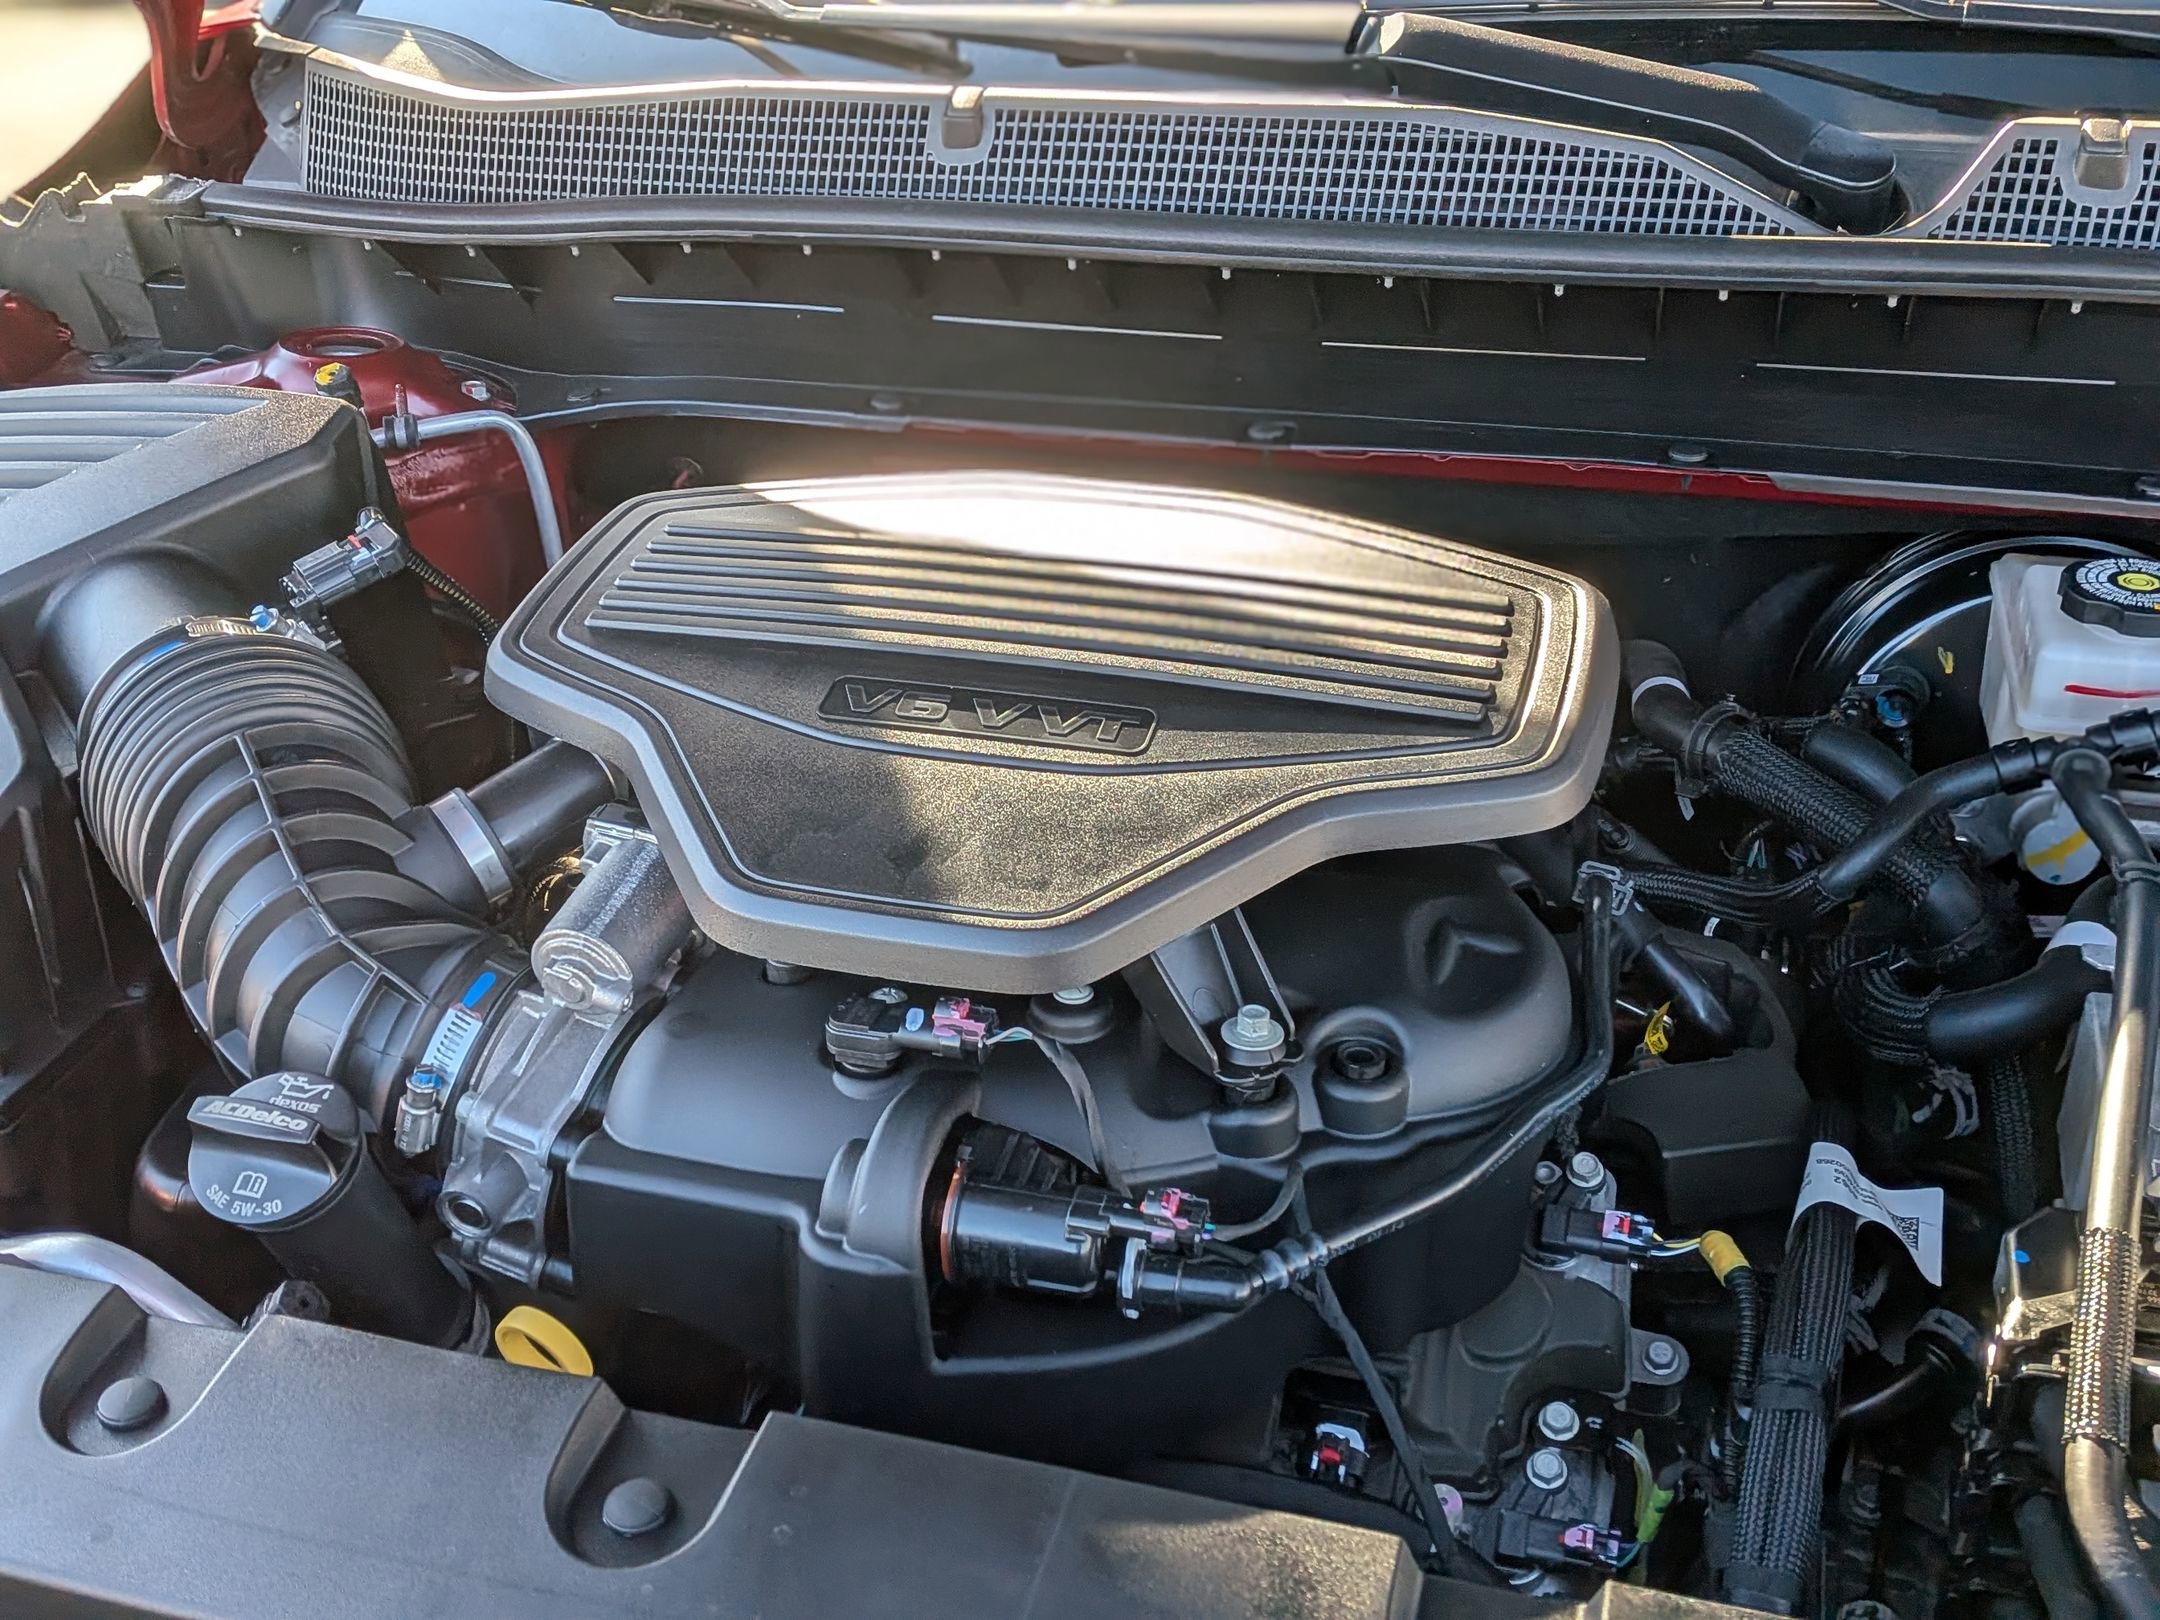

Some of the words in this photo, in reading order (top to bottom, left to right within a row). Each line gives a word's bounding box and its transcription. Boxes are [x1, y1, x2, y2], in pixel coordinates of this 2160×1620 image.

[845, 684, 951, 722] V6
[973, 697, 1140, 742] VVT
[203, 1100, 308, 1132] ACDelco
[206, 1184, 230, 1209] SAE
[231, 1199, 282, 1217] 5W-30
